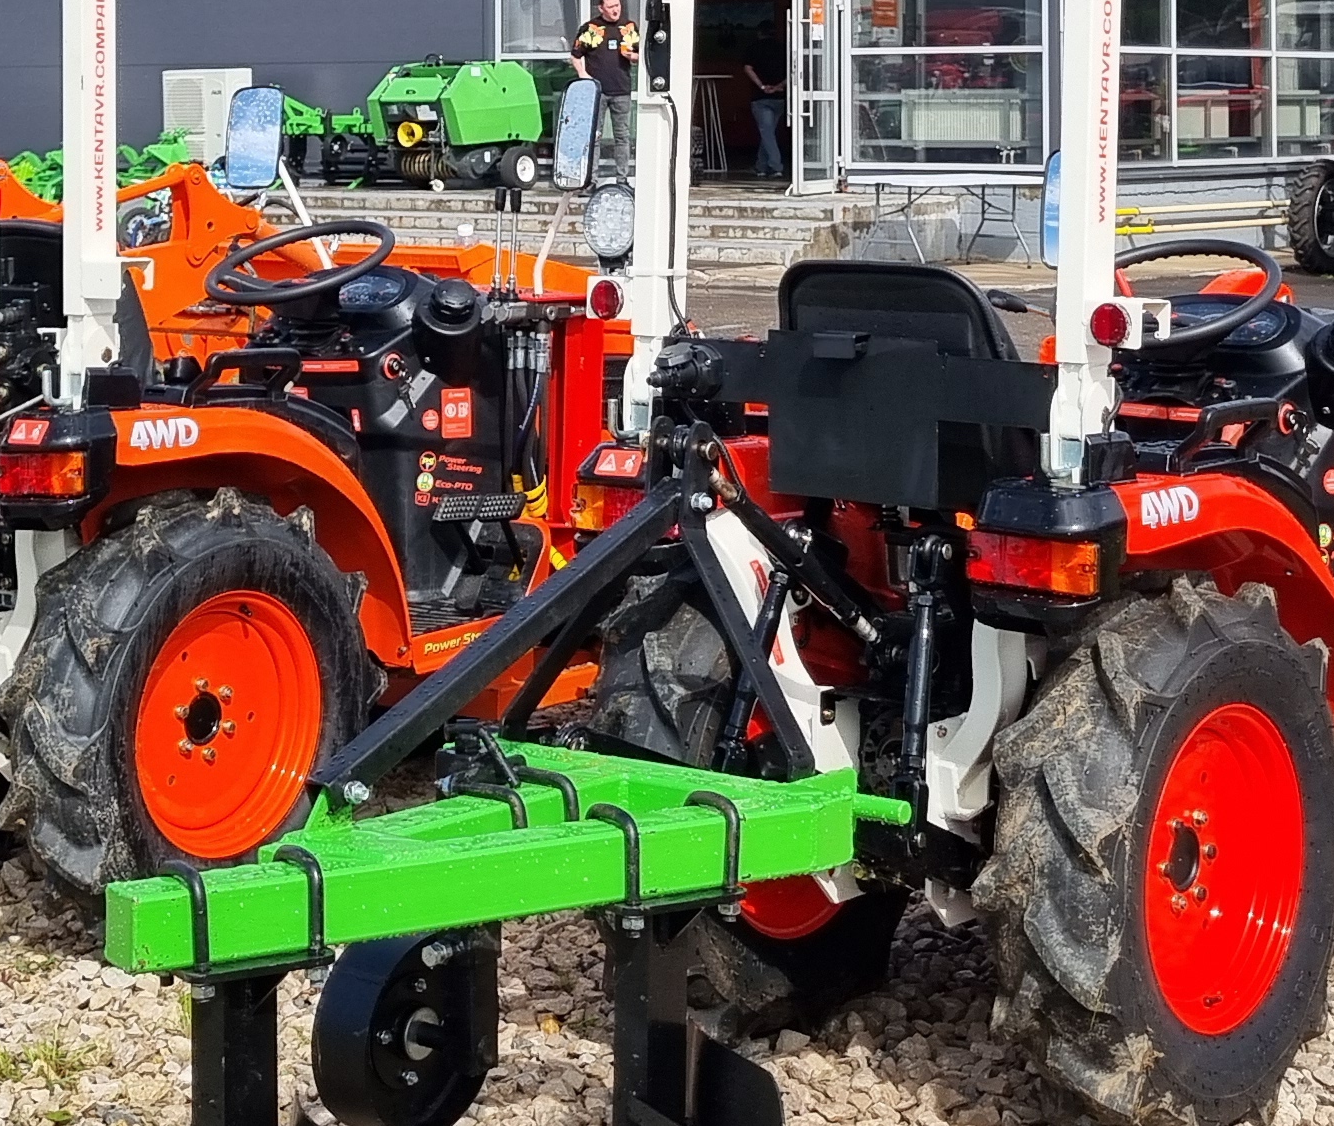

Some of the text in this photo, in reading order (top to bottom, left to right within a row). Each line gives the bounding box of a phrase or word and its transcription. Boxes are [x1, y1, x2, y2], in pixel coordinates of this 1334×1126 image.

[129, 416, 200, 451] 4WD
[438, 454, 467, 464] Power
[446, 463, 483, 474] Steering
[434, 479, 473, 491] Eco-PTO
[1140, 484, 1200, 529] 4WD
[424, 636, 462, 655] Power
